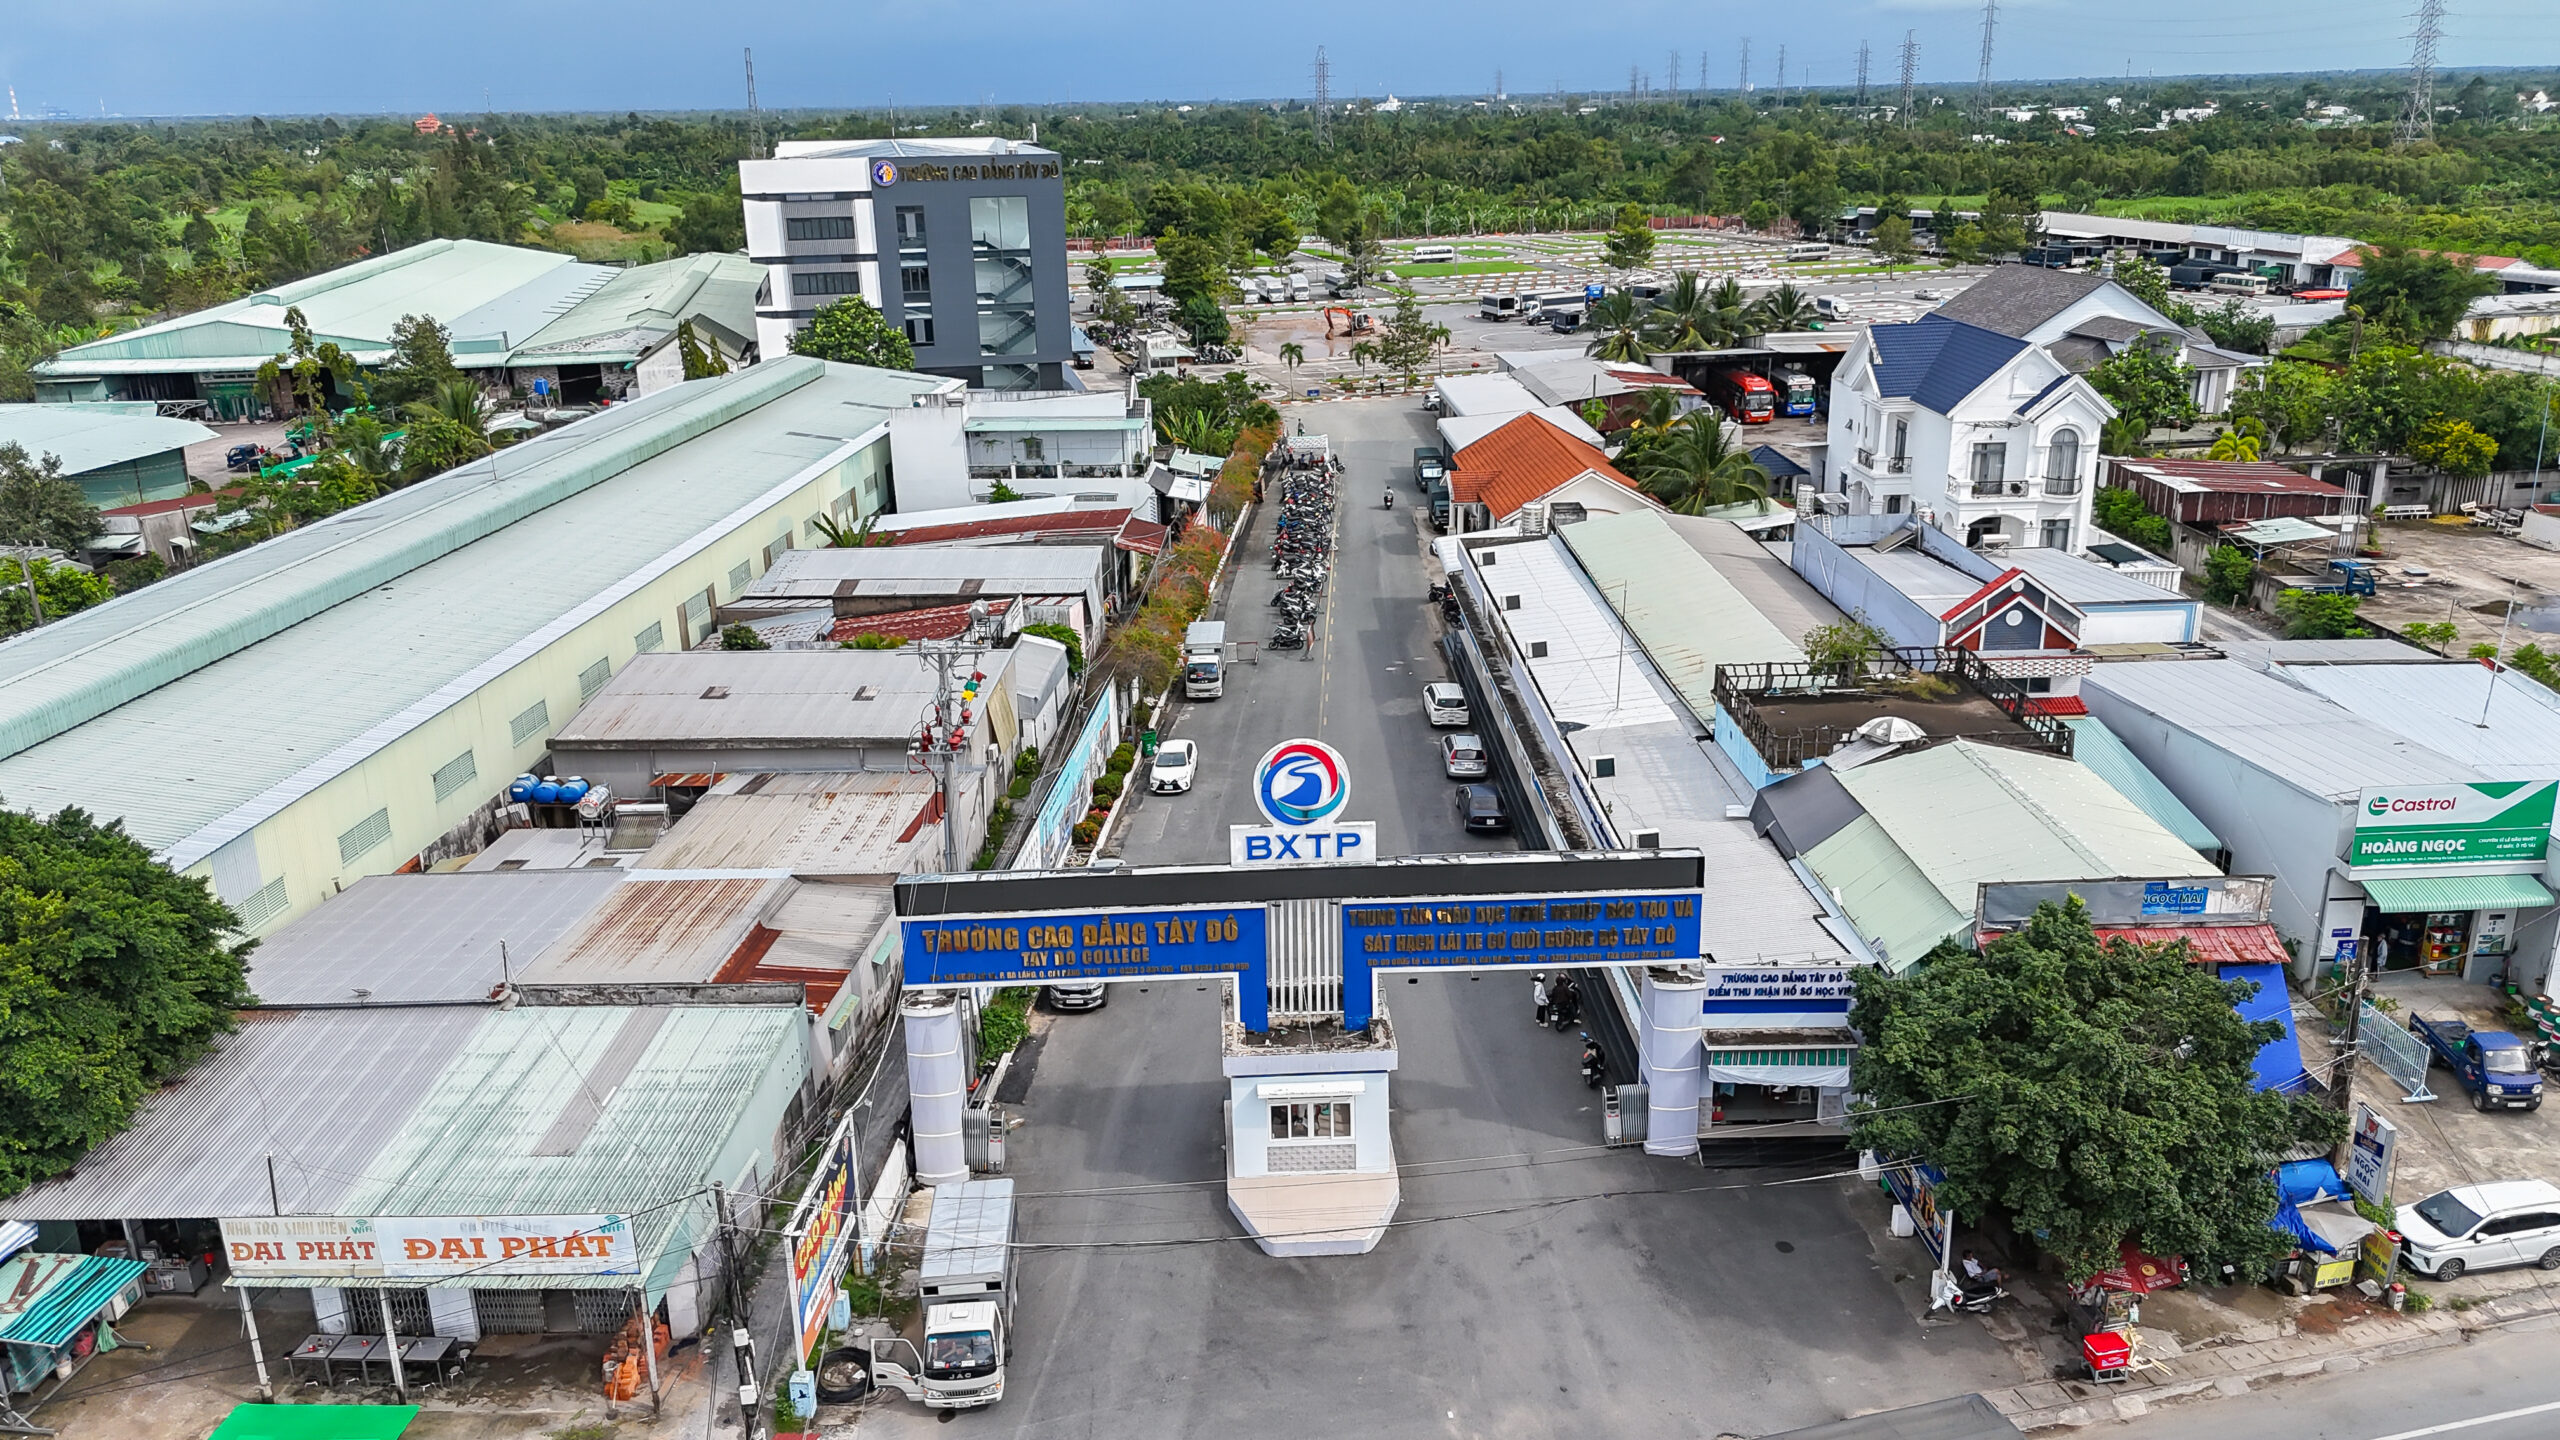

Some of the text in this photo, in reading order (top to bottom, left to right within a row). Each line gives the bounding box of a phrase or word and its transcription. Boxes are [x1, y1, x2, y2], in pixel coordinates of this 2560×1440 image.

[953, 165, 977, 181] CAO
[1016, 160, 1039, 180] TÂY
[1041, 160, 1059, 178] ĐÔ
[2391, 797, 2457, 812] Castrol
[1245, 833, 1361, 860] BXTP
[2361, 839, 2467, 855] HOÀNG NGỌC
[2178, 893, 2204, 904] MAI
[1349, 908, 1396, 926] TRUNG
[1401, 905, 1433, 925] TÂM
[1437, 904, 1471, 924] GIÁO
[1476, 905, 1505, 926] DỤC
[1641, 900, 1668, 920] TẠO
[1674, 896, 1694, 918] VÀ
[922, 923, 1019, 953] TRƯỜNG
[1028, 925, 1073, 949] CAO
[1155, 916, 1197, 944] TÂY
[1206, 913, 1238, 943] ĐÔ
[1364, 932, 1392, 952] SÁT
[1396, 934, 1435, 954] HẠCH
[1440, 930, 1461, 951] LÁI
[1466, 933, 1483, 950] XE
[1487, 929, 1506, 949] CƠ
[1511, 928, 1540, 949] GIỚI
[1598, 925, 1618, 948] BỘ
[1623, 925, 1650, 945] TÂY
[1655, 923, 1676, 944] ĐÔ
[1021, 947, 1150, 967] TAY DO COLLEGE
[1761, 974, 1779, 983] CAO
[1809, 972, 1827, 983] TÂY
[1829, 971, 1843, 982] ĐÔ
[1732, 987, 1751, 996] THU
[1754, 985, 1780, 998] NHẬN
[1800, 986, 1812, 996] SƠ
[1815, 987, 1835, 998] HỌC
[2354, 1155, 2375, 1178] NGỌC
[2355, 1168, 2370, 1187] MAI
[285, 1221, 314, 1235] SINH
[230, 1236, 375, 1264] ĐẠI PHÁT
[403, 1229, 613, 1264] ĐẠI PHÁT
[800, 1219, 820, 1269] CAO
